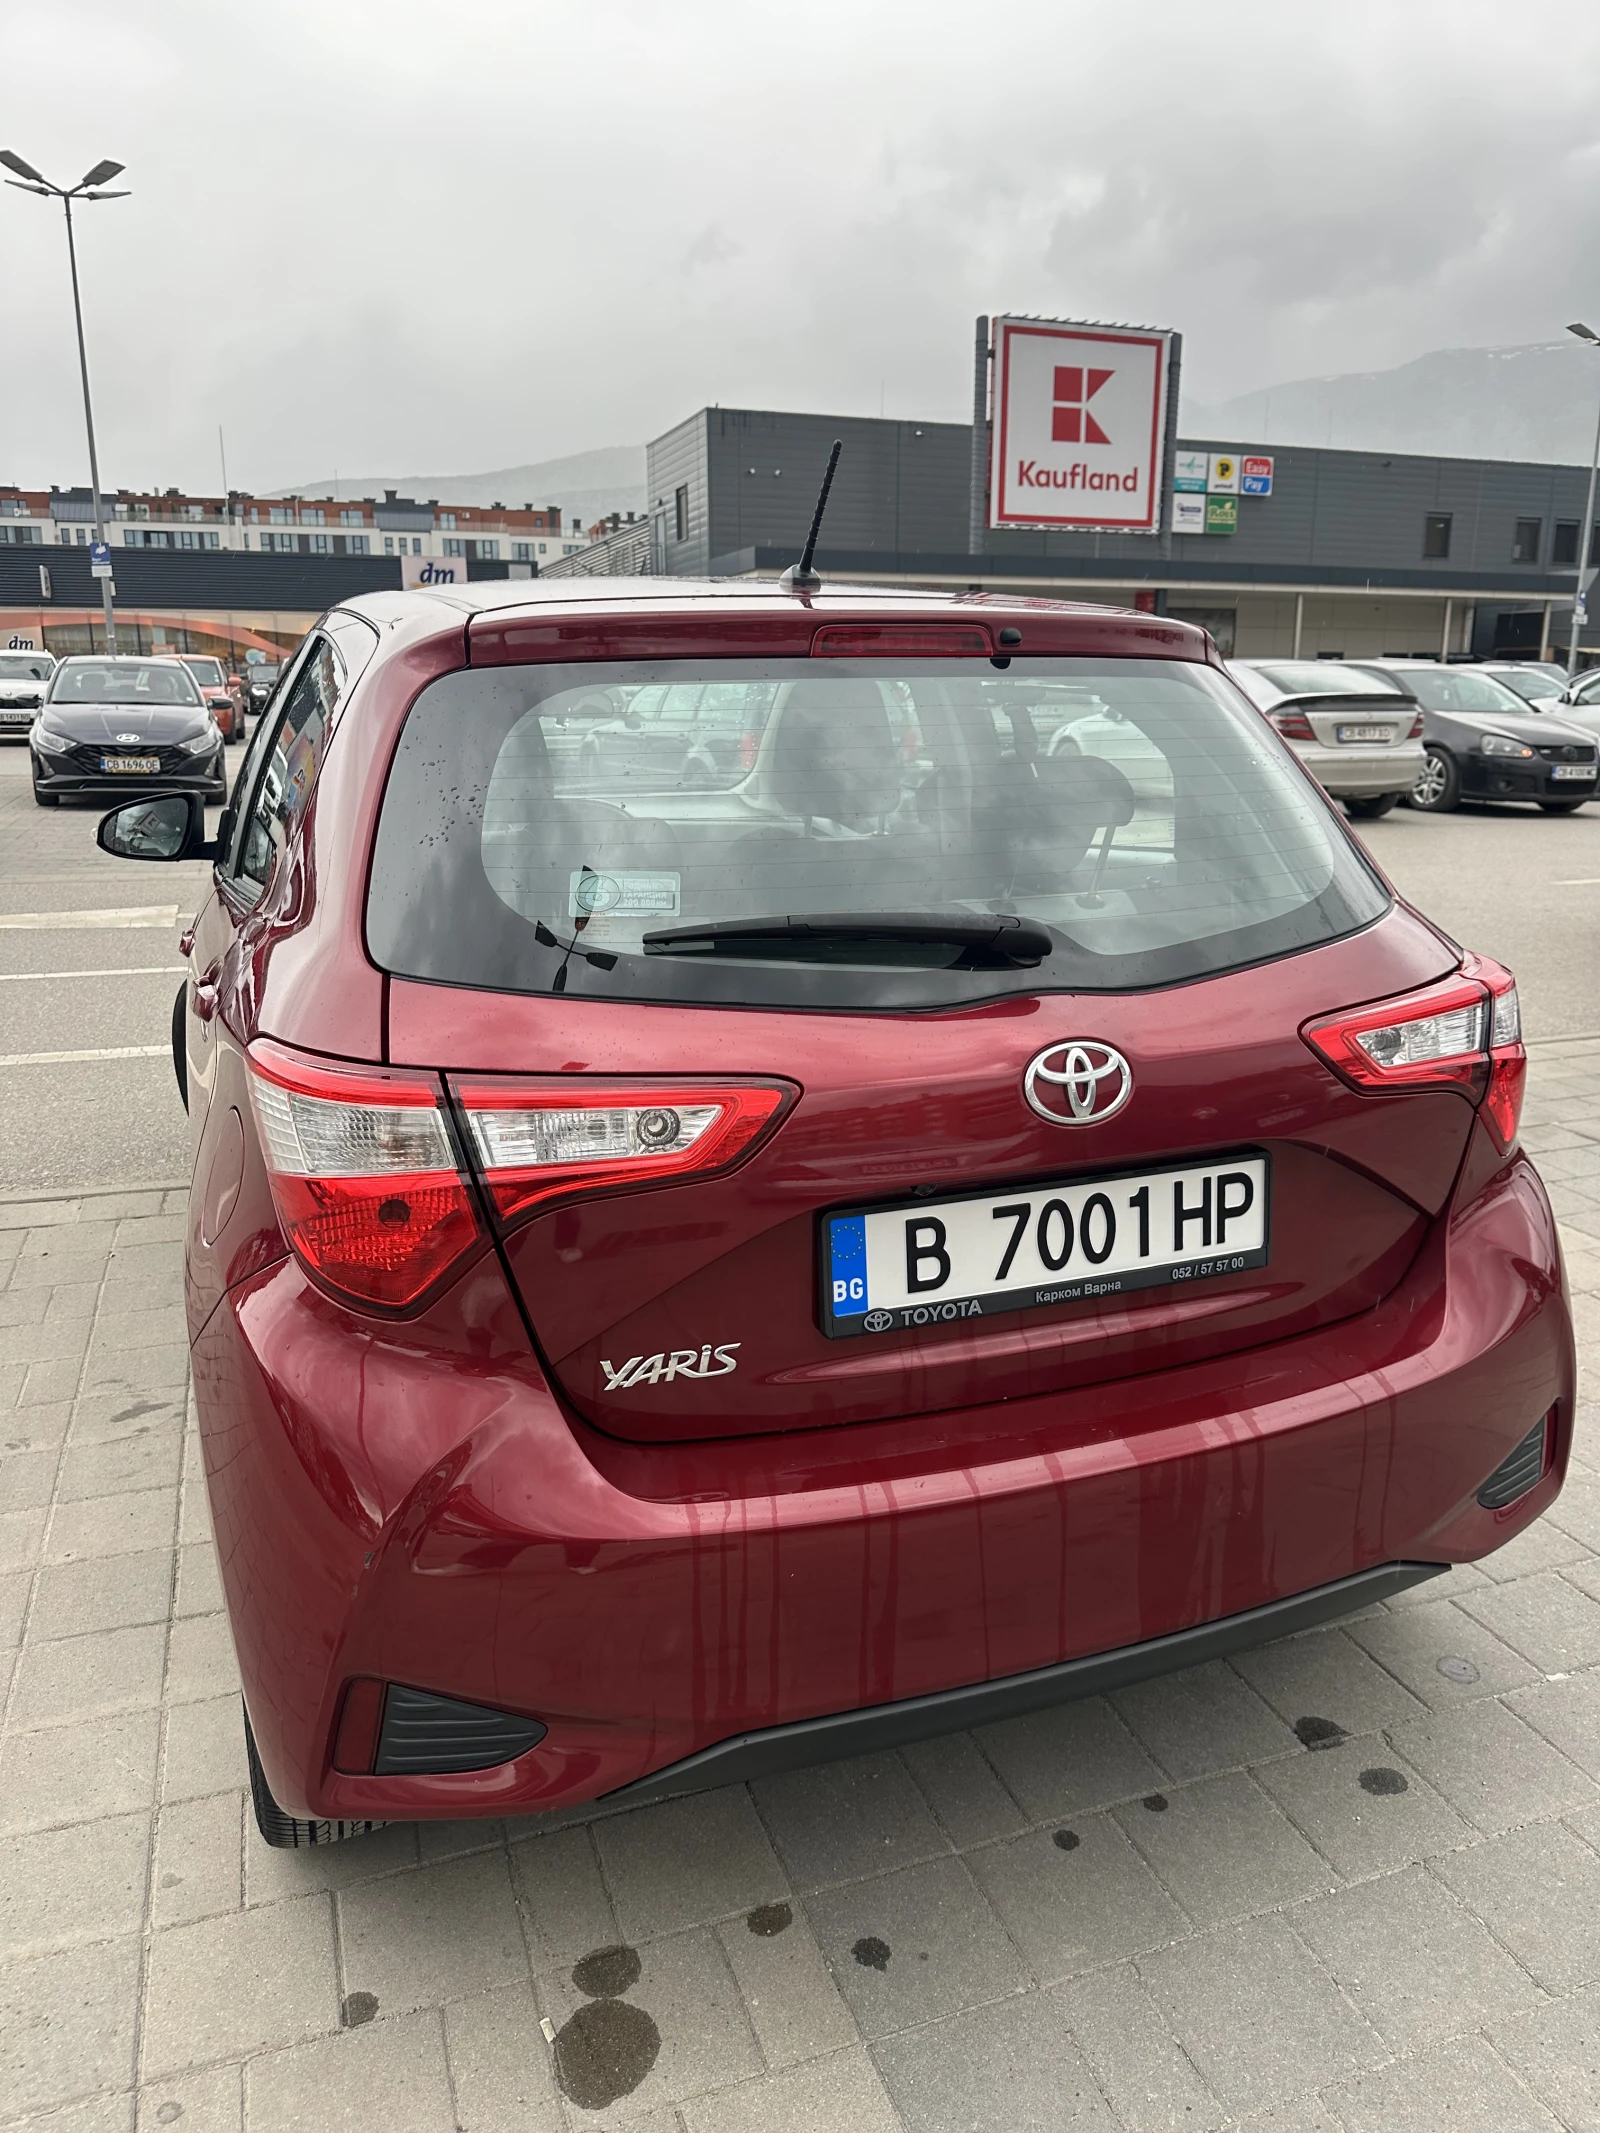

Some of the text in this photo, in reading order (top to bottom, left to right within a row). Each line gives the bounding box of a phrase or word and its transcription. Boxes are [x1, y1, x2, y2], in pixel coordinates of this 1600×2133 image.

[1018, 460, 1138, 492] Kaufland
[1245, 461, 1270, 476] Easy
[1244, 477, 1264, 492] Pay
[420, 562, 455, 583] dm
[9, 635, 34, 650] dm
[107, 760, 119, 770] CB
[122, 760, 144, 770] 1696
[623, 891, 667, 900] ГАРАНЦИЯ
[623, 899, 639, 907] 200
[641, 899, 655, 907] 000
[905, 1171, 1254, 1294] B 7001 HP
[1172, 1256, 1244, 1280] 052 / 57 57 00
[833, 1277, 864, 1303] BG
[1035, 1281, 1121, 1303] Карком Варна
[901, 1299, 983, 1326] TOYOTA
